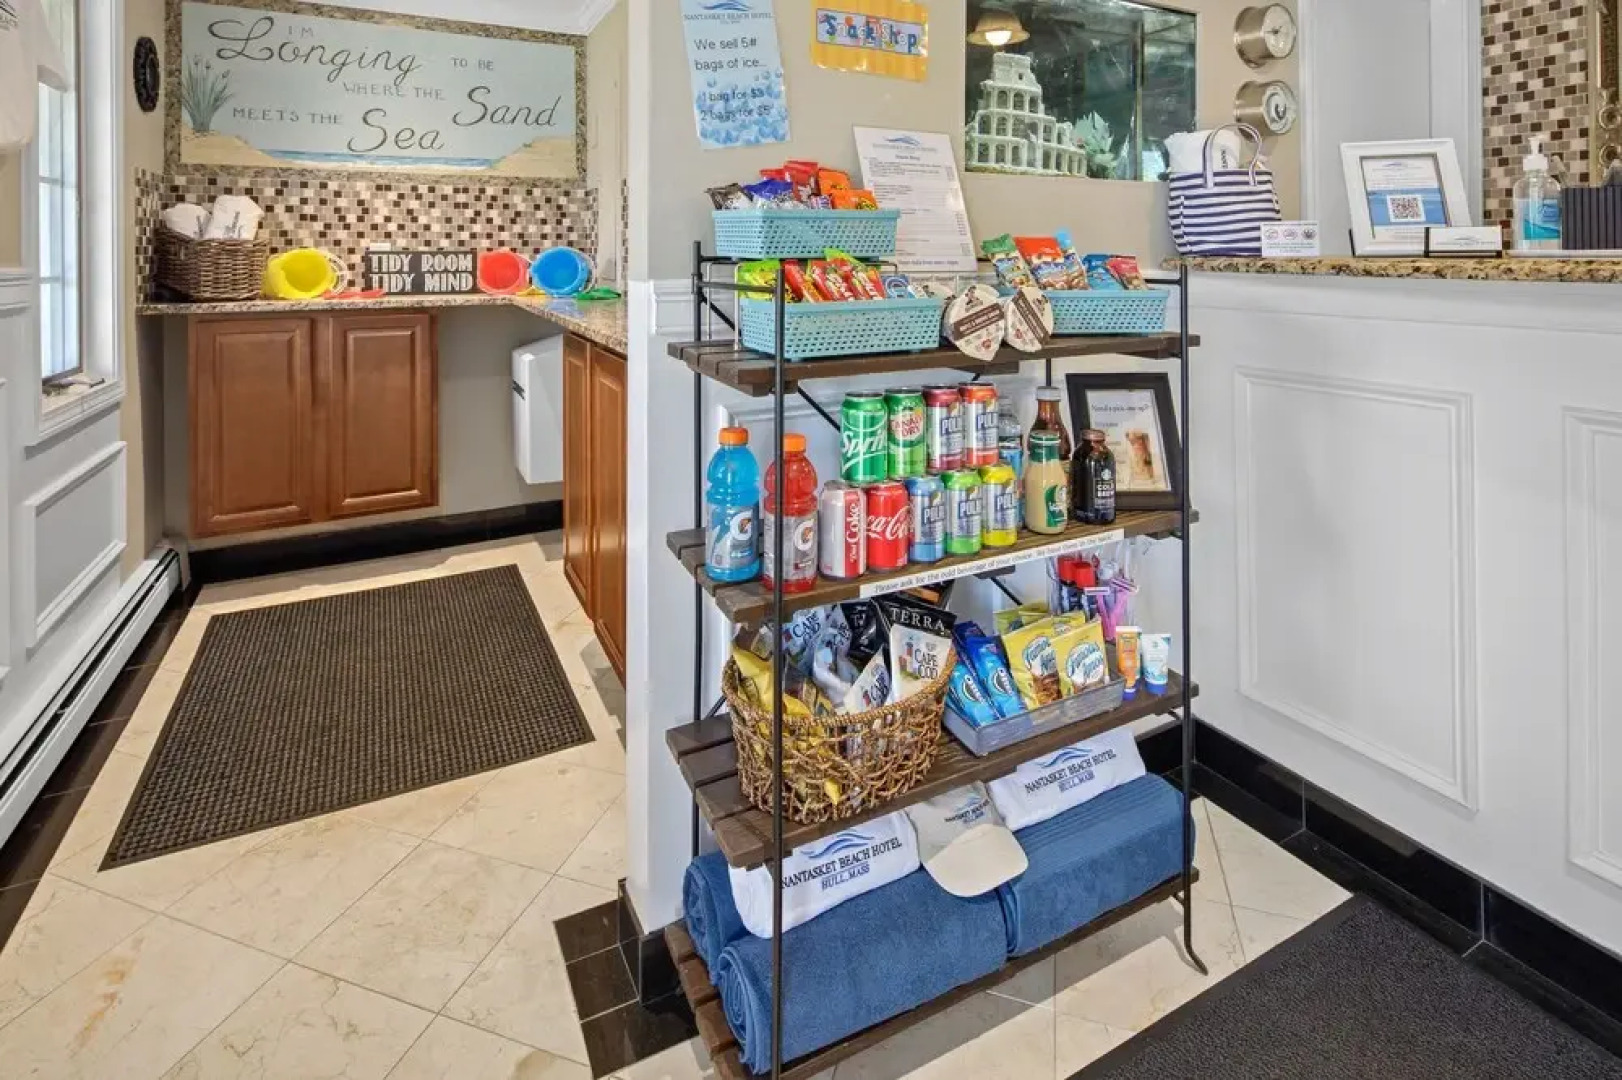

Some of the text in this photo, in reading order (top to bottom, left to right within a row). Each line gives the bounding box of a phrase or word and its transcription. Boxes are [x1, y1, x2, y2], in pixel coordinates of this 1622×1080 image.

[694, 36, 757, 50] We sell 5#
[882, 23, 918, 54] Shop
[207, 16, 494, 86] Longing TO BE
[694, 59, 724, 72] bags
[727, 58, 738, 68] of
[342, 82, 562, 127] WHERE THE Sand
[709, 91, 729, 103] bag
[732, 88, 747, 99] for
[701, 109, 707, 120] 2
[709, 109, 737, 123] bags
[739, 108, 754, 117] for
[232, 107, 445, 153] MEETS THE Sea
[369, 254, 473, 273] TIDY ROOM
[369, 274, 474, 293] TIDY MIND
[846, 503, 860, 542] Coke
[900, 578, 913, 587] ask
[915, 575, 925, 584] for
[928, 572, 940, 581] the
[889, 608, 946, 634] TERRA
[914, 648, 938, 667] CAPE
[918, 664, 938, 680] COD
[1024, 749, 1117, 794] NANTASKET BEACH HOTEL
[780, 837, 903, 890] NANTASKET BEACH HOTEL
[850, 863, 870, 878] MASS
